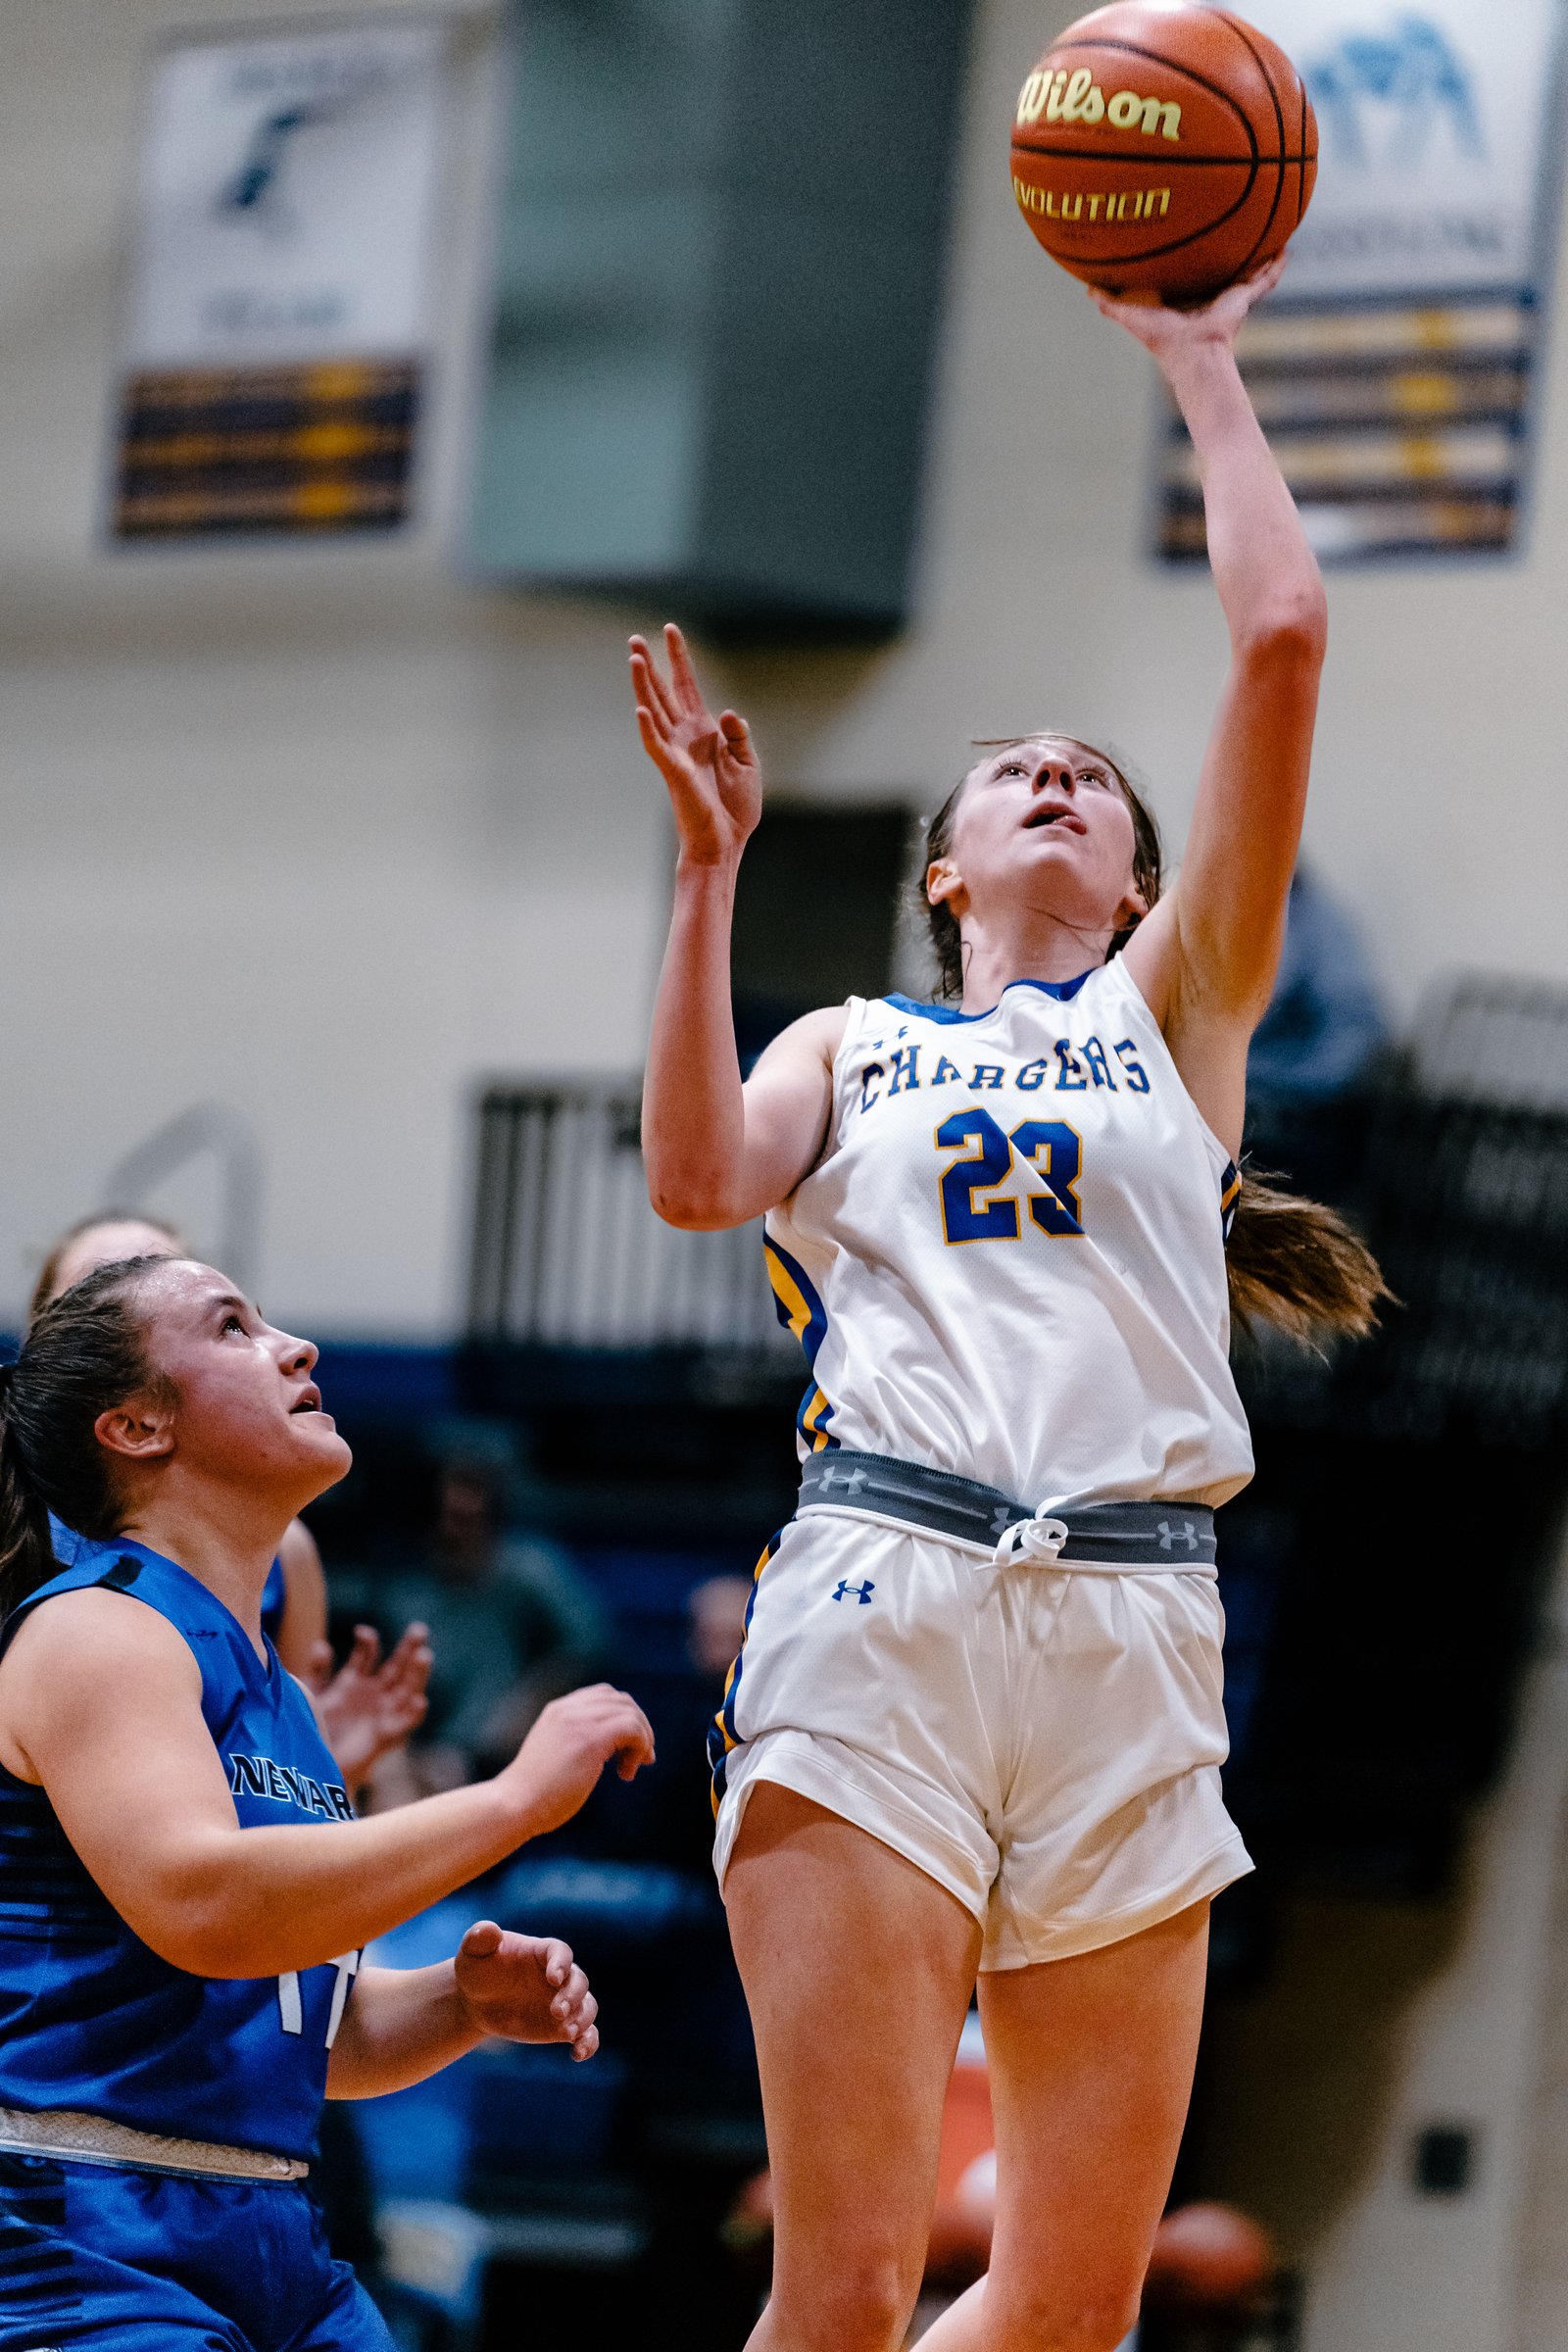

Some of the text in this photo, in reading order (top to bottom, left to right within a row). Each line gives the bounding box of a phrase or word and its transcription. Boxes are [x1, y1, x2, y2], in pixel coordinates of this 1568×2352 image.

[1017, 68, 1182, 141] Wilson
[860, 1036, 1152, 1114] CHARGERS
[934, 1105, 1087, 1246] 23
[228, 1752, 354, 1823] NEWAR
